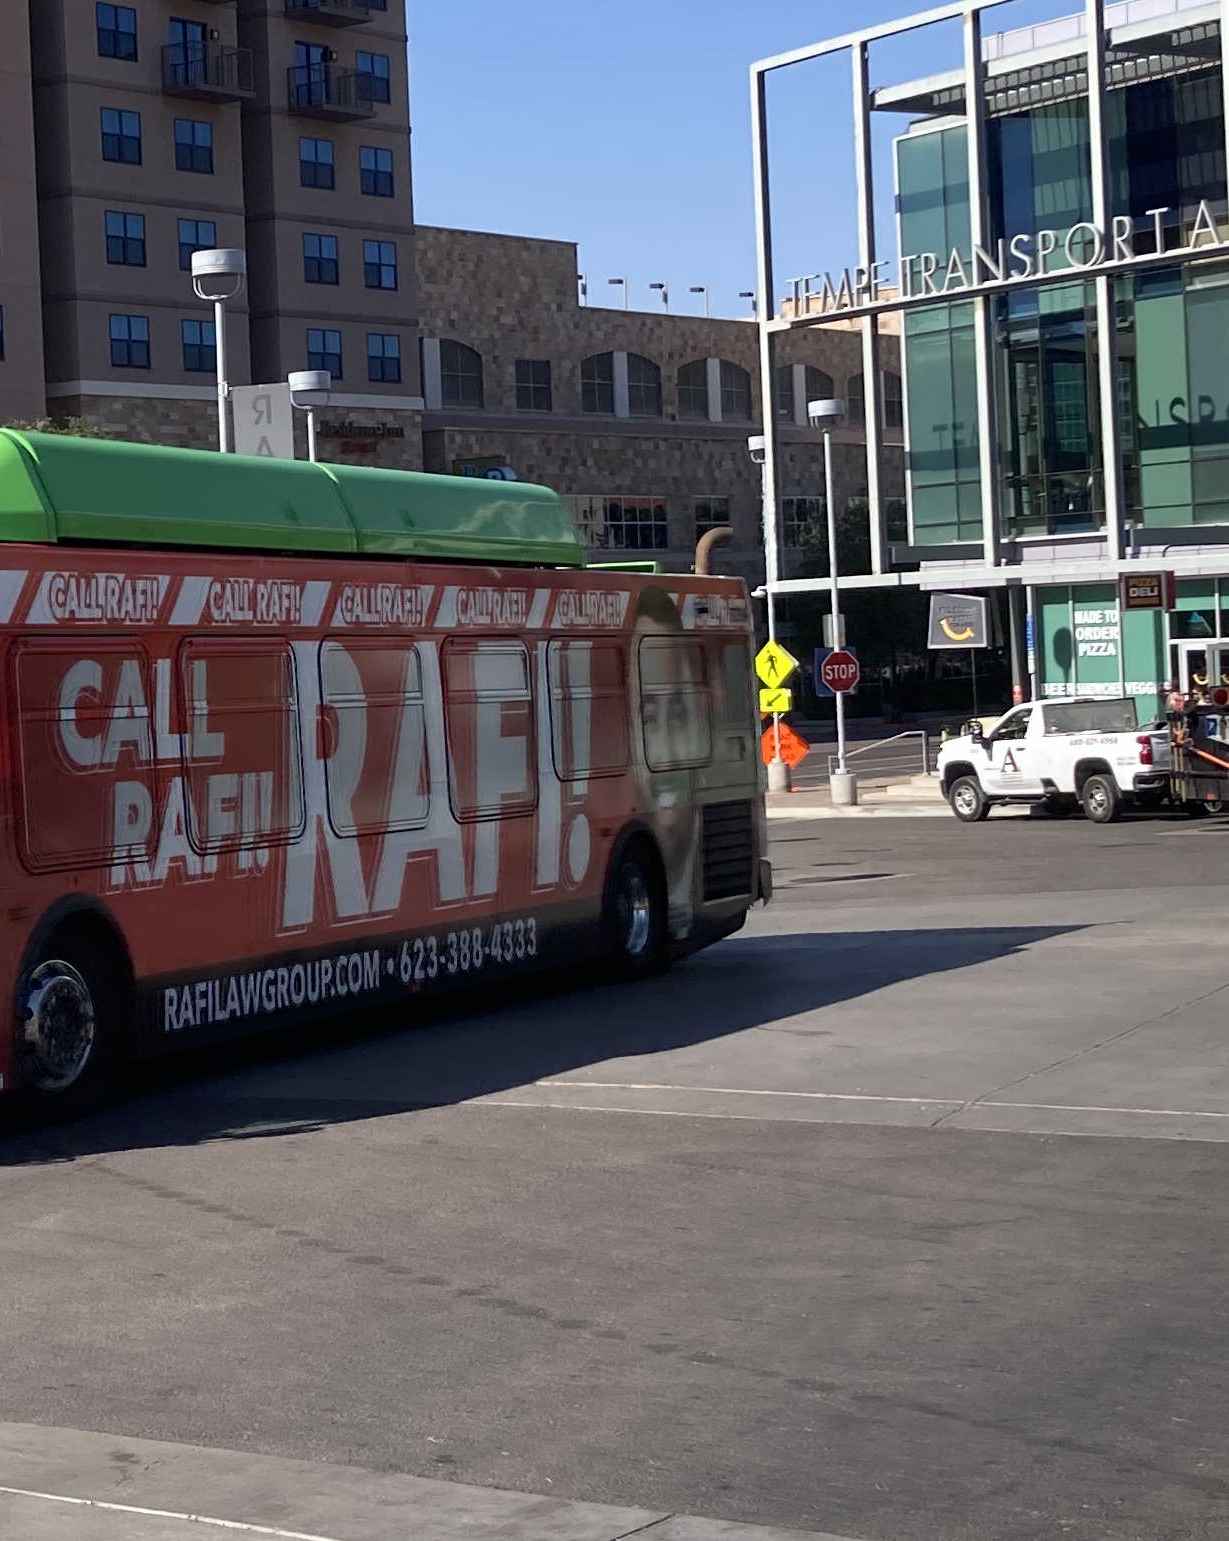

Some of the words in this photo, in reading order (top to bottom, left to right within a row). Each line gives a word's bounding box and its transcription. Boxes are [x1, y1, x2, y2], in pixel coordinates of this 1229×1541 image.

[786, 260, 890, 317] TEMPE
[50, 575, 104, 621] CALL
[210, 579, 255, 624] CALL
[1075, 627, 1119, 640] ORDER
[1079, 642, 1116, 656] PIZZA
[825, 664, 856, 680] STOP
[58, 658, 226, 770] CALL
[1001, 747, 1021, 773] A
[278, 640, 593, 932] RAFI!
[164, 949, 381, 1033] RAFILAWGROUP.COM
[399, 916, 538, 985] 623-388-4333
